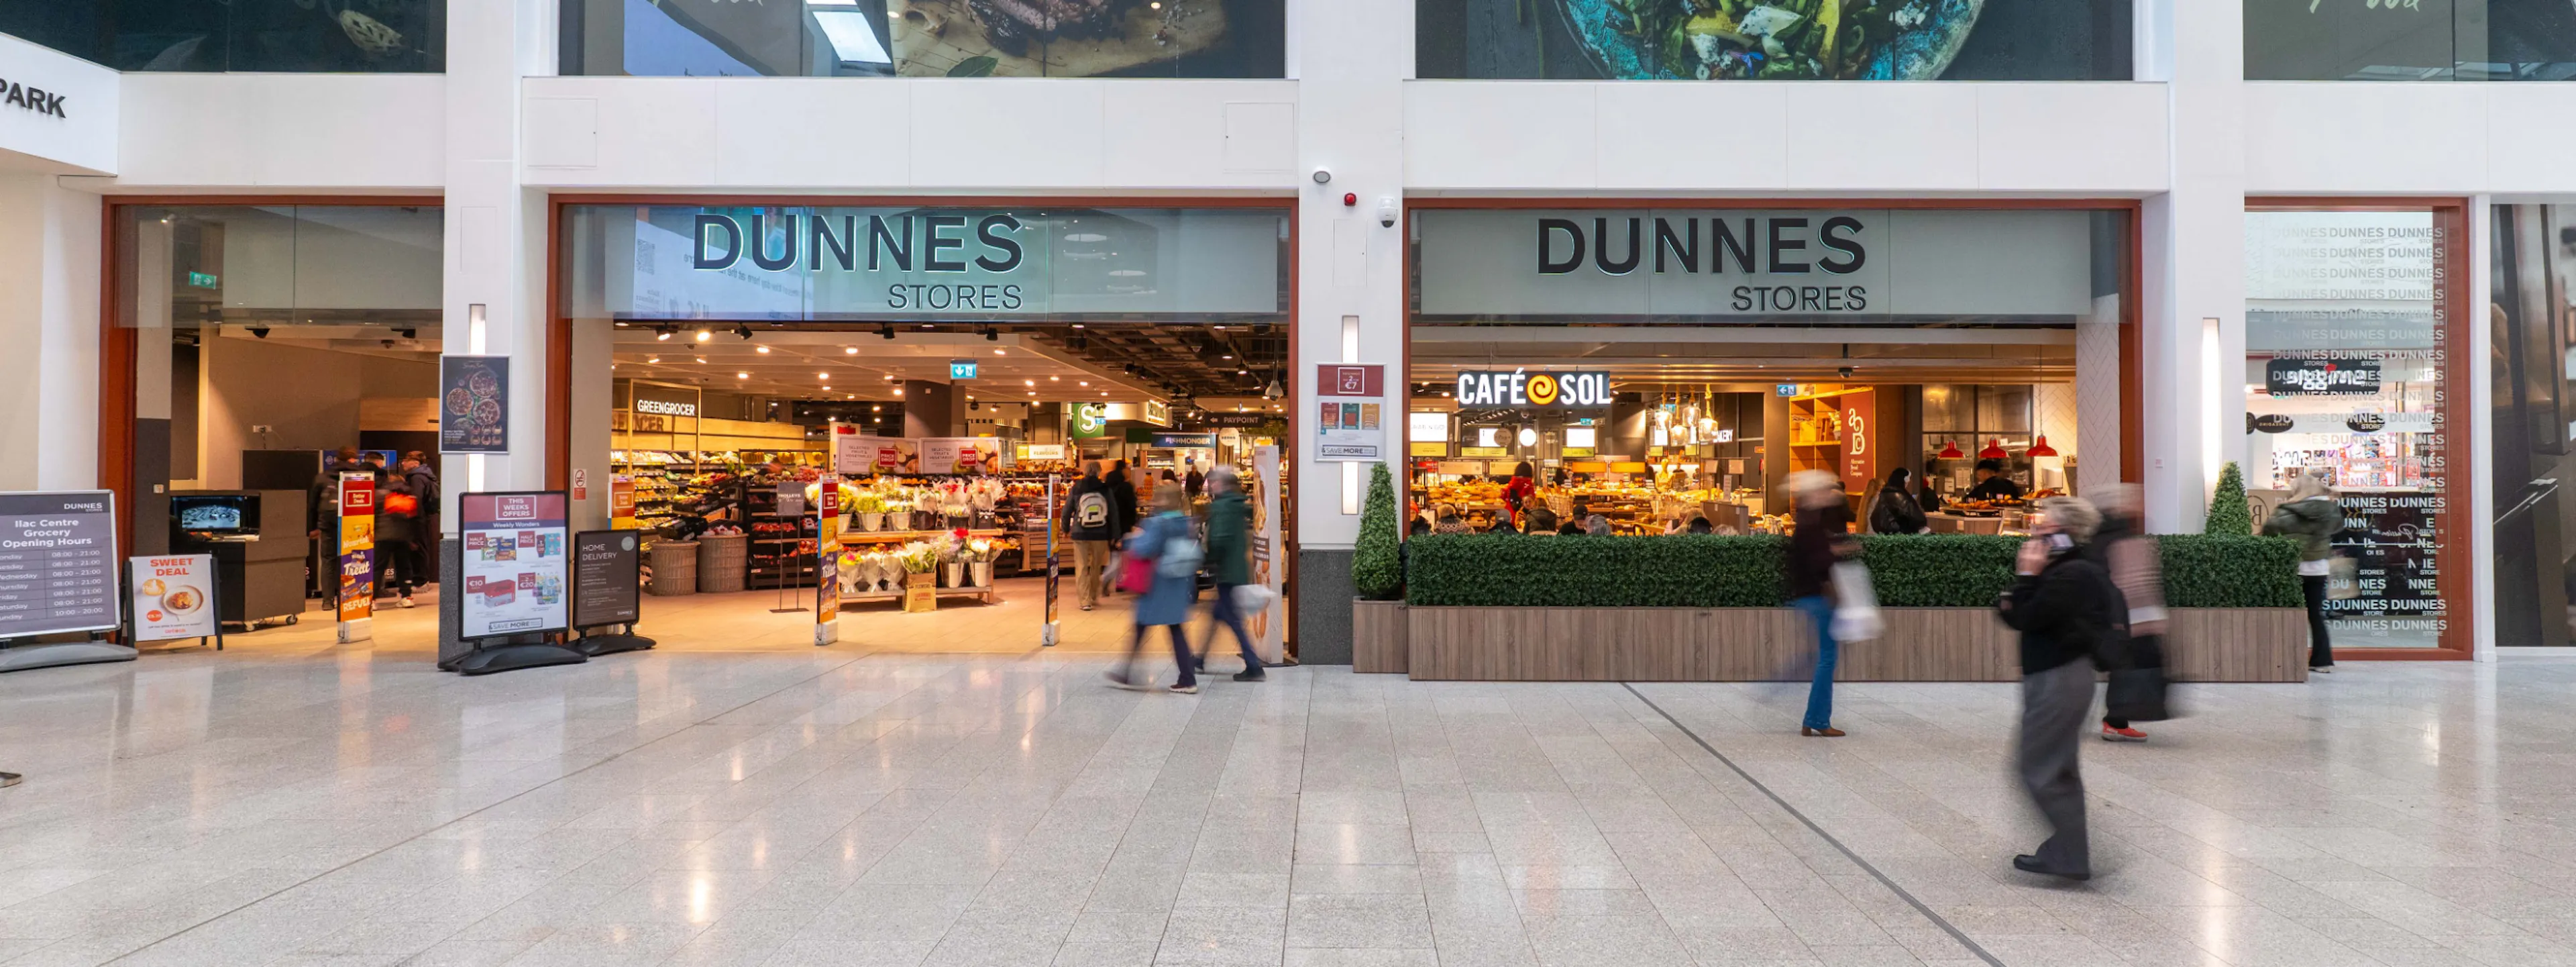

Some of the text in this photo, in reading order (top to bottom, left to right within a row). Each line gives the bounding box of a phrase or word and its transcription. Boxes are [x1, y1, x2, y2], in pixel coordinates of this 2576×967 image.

[2330, 227, 2384, 238] DUNNES
[2388, 227, 2443, 238] DUNNES
[694, 213, 1024, 273] DUNNES
[1536, 215, 1866, 276] DUNNES
[2330, 248, 2384, 258] DUNNES
[2388, 248, 2443, 258] DUNNES
[2330, 268, 2385, 278] DUNNES
[2389, 268, 2444, 278] DUNNES
[888, 283, 1024, 310] STORES
[1731, 285, 1867, 312] STORES
[2330, 289, 2385, 299] DUNNES
[2389, 289, 2444, 299] DUNNES
[2330, 329, 2385, 340] DUNNES
[2389, 329, 2445, 340] DUNNES
[2273, 350, 2445, 360] DUNNES DUNNES DUNNES
[1458, 367, 1611, 405] CAFÉ SOL
[637, 399, 695, 416] GREENGROCER
[2330, 413, 2385, 423] DUNNES
[2390, 413, 2445, 423] DUNNES
[1165, 437, 1211, 445] FISHMONGER
[2390, 497, 2445, 507] DUNNES
[23, 529, 70, 538] Grocery
[3, 538, 92, 548] Opening Hours
[582, 544, 606, 552] HOME
[582, 552, 617, 561] DELIVERY
[150, 558, 194, 567] SWEET
[156, 568, 190, 576] DEAL
[343, 560, 371, 576] Treat
[343, 596, 371, 613] REFUEL
[2332, 599, 2388, 610] DUNNES
[2391, 599, 2447, 610] DUNNES
[2333, 620, 2447, 630] DUNNES DUNNES
